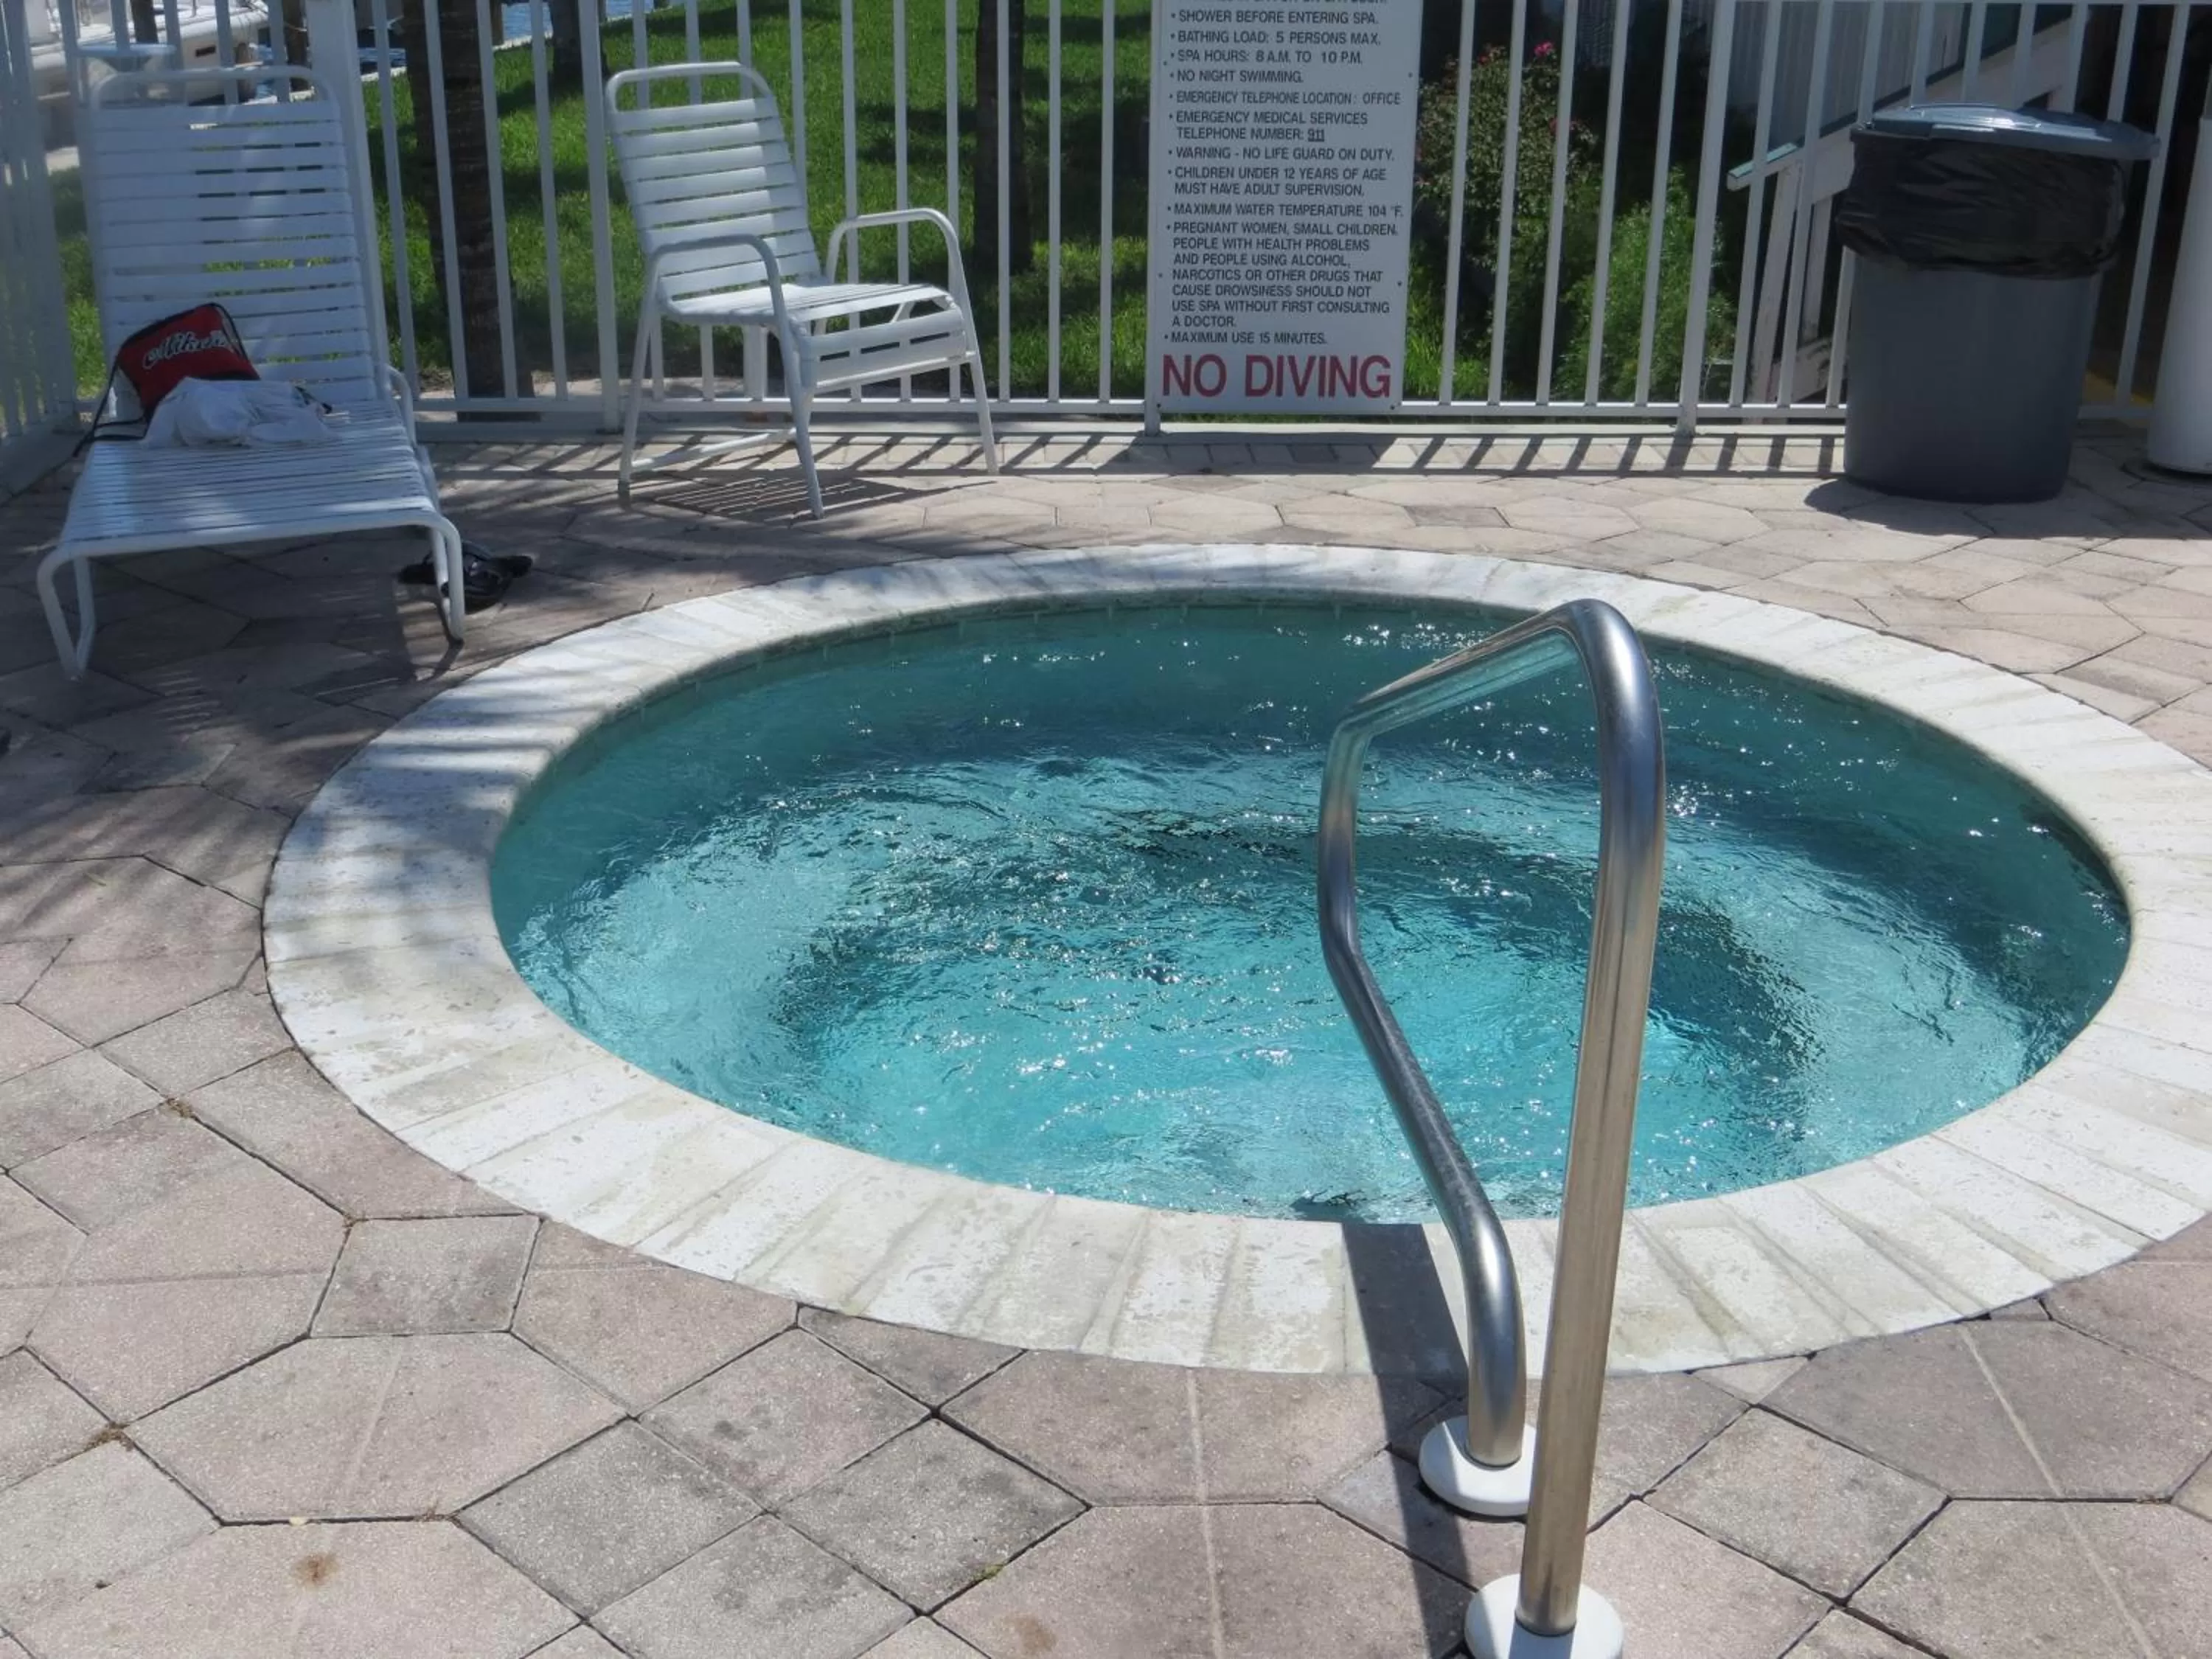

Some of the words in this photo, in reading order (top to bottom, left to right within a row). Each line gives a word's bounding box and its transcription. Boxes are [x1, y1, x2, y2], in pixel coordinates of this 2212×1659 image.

[1178, 11, 1232, 23] SHOWER
[1237, 11, 1284, 23] BEFORE
[1289, 12, 1349, 24] ENTERING
[1353, 13, 1379, 24] SPA.
[1178, 31, 1229, 43] BATHING
[1234, 32, 1269, 43] LOAD:
[1276, 32, 1284, 43] 5
[1290, 32, 1346, 44] PERSONS
[1178, 51, 1200, 61] SPA
[1204, 51, 1249, 61] HOURS:
[1256, 51, 1264, 62] 8
[1295, 52, 1312, 62] TO
[1321, 52, 1337, 63] 10
[1178, 71, 1195, 81] NO
[1199, 71, 1234, 82] NIGHT
[1176, 92, 1238, 103] EMERGENCY
[1242, 92, 1300, 104] TELEPHONE
[1363, 93, 1400, 105] OFFICE
[1176, 112, 1250, 123] EMERGENCY
[1253, 112, 1306, 123] MEDICAL
[1310, 113, 1368, 124] SERVICES
[1178, 128, 1246, 139] TELEPHONE
[1251, 128, 1304, 139] NUMBER:
[1308, 129, 1325, 142] 911
[1176, 147, 1231, 159] WARNING
[1242, 148, 1260, 159] NO
[1265, 148, 1289, 159] LIFE
[1293, 148, 1335, 159] GUARD
[1338, 149, 1356, 159] ON
[1360, 149, 1394, 160] DUTY.
[1175, 167, 1234, 178] CHILDREN
[1239, 167, 1279, 178] UNDER
[1284, 167, 1294, 178] 12
[1299, 168, 1338, 179] YEARS
[1343, 169, 1358, 179] OF
[1363, 169, 1386, 180] AGE
[1175, 183, 1206, 194] MUST
[1210, 184, 1240, 195] HAVE
[1244, 184, 1280, 195] ADULT
[1174, 204, 1232, 215] MAXIMUM
[1237, 204, 1275, 215] WATER
[1279, 205, 1363, 216] TEMPERATURE
[1368, 206, 1386, 217] 104
[1174, 222, 1238, 233] PREGNANT
[1294, 223, 1333, 234] SMALL
[1173, 238, 1218, 249] PEOPLE
[1222, 238, 1252, 249] WITH
[1256, 239, 1301, 250] HEALTH
[1306, 240, 1369, 251] PROBLEMS
[1173, 254, 1198, 264] AND
[1203, 254, 1248, 265] PEOPLE
[1252, 254, 1287, 265] USING
[1291, 255, 1351, 268] ALCOHOL,
[1172, 270, 1241, 280] NARCOTICS
[1245, 270, 1262, 281] OR
[1266, 271, 1305, 281] OTHER
[1310, 271, 1349, 282] DRUGS
[1354, 271, 1383, 282] THAT
[1172, 285, 1211, 296] CAUSE
[1216, 285, 1292, 296] DROWSINESS
[1295, 286, 1343, 296] SHOULD
[1348, 286, 1371, 297] NOT
[1172, 301, 1195, 311] USE
[1199, 301, 1220, 312] SPA
[1224, 302, 1277, 312] WITHOUT
[1282, 302, 1313, 313] FIRST
[1317, 302, 1390, 313] CONSULTING
[1172, 316, 1180, 327] A
[1172, 333, 1228, 344] MAXIMUM
[1231, 333, 1254, 344] USE
[1259, 333, 1270, 344] 15
[1274, 333, 1326, 344] MINUTES.
[1163, 354, 1227, 397] NO
[1245, 354, 1391, 399] DIVING
